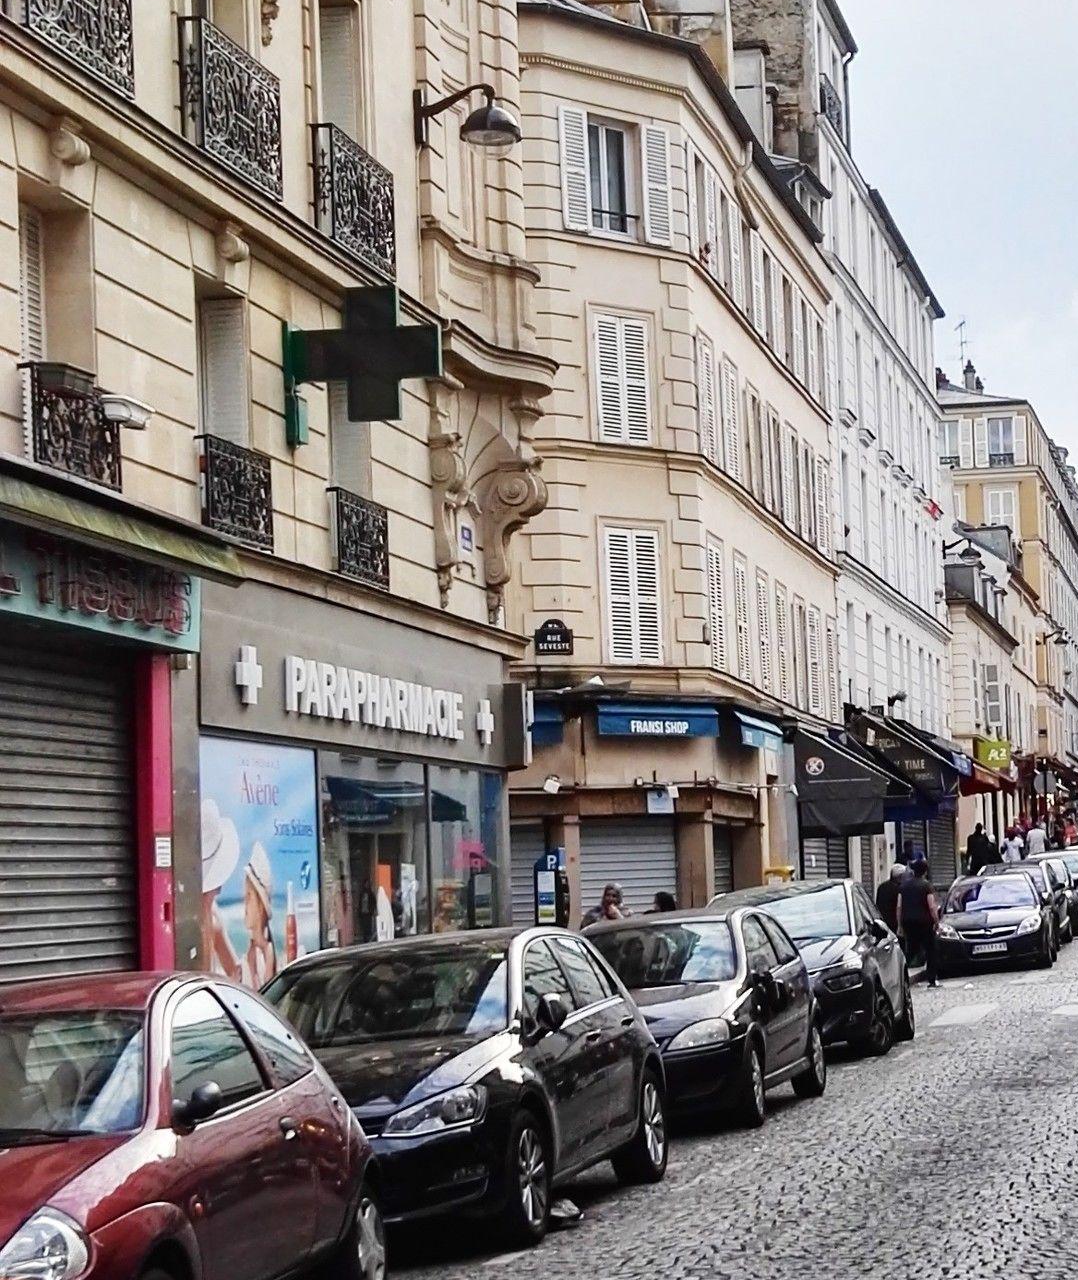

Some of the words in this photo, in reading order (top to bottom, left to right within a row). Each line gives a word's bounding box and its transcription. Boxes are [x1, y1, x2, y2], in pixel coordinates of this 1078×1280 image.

[546, 634, 562, 642] RUE
[539, 642, 570, 650] SEVESTE
[285, 655, 464, 740] PARAPHARMACIE
[631, 720, 664, 734] FRANSI
[665, 720, 689, 734] SHOP
[904, 759, 925, 770] TIME
[241, 771, 279, 806] Avène
[546, 854, 557, 870] P
